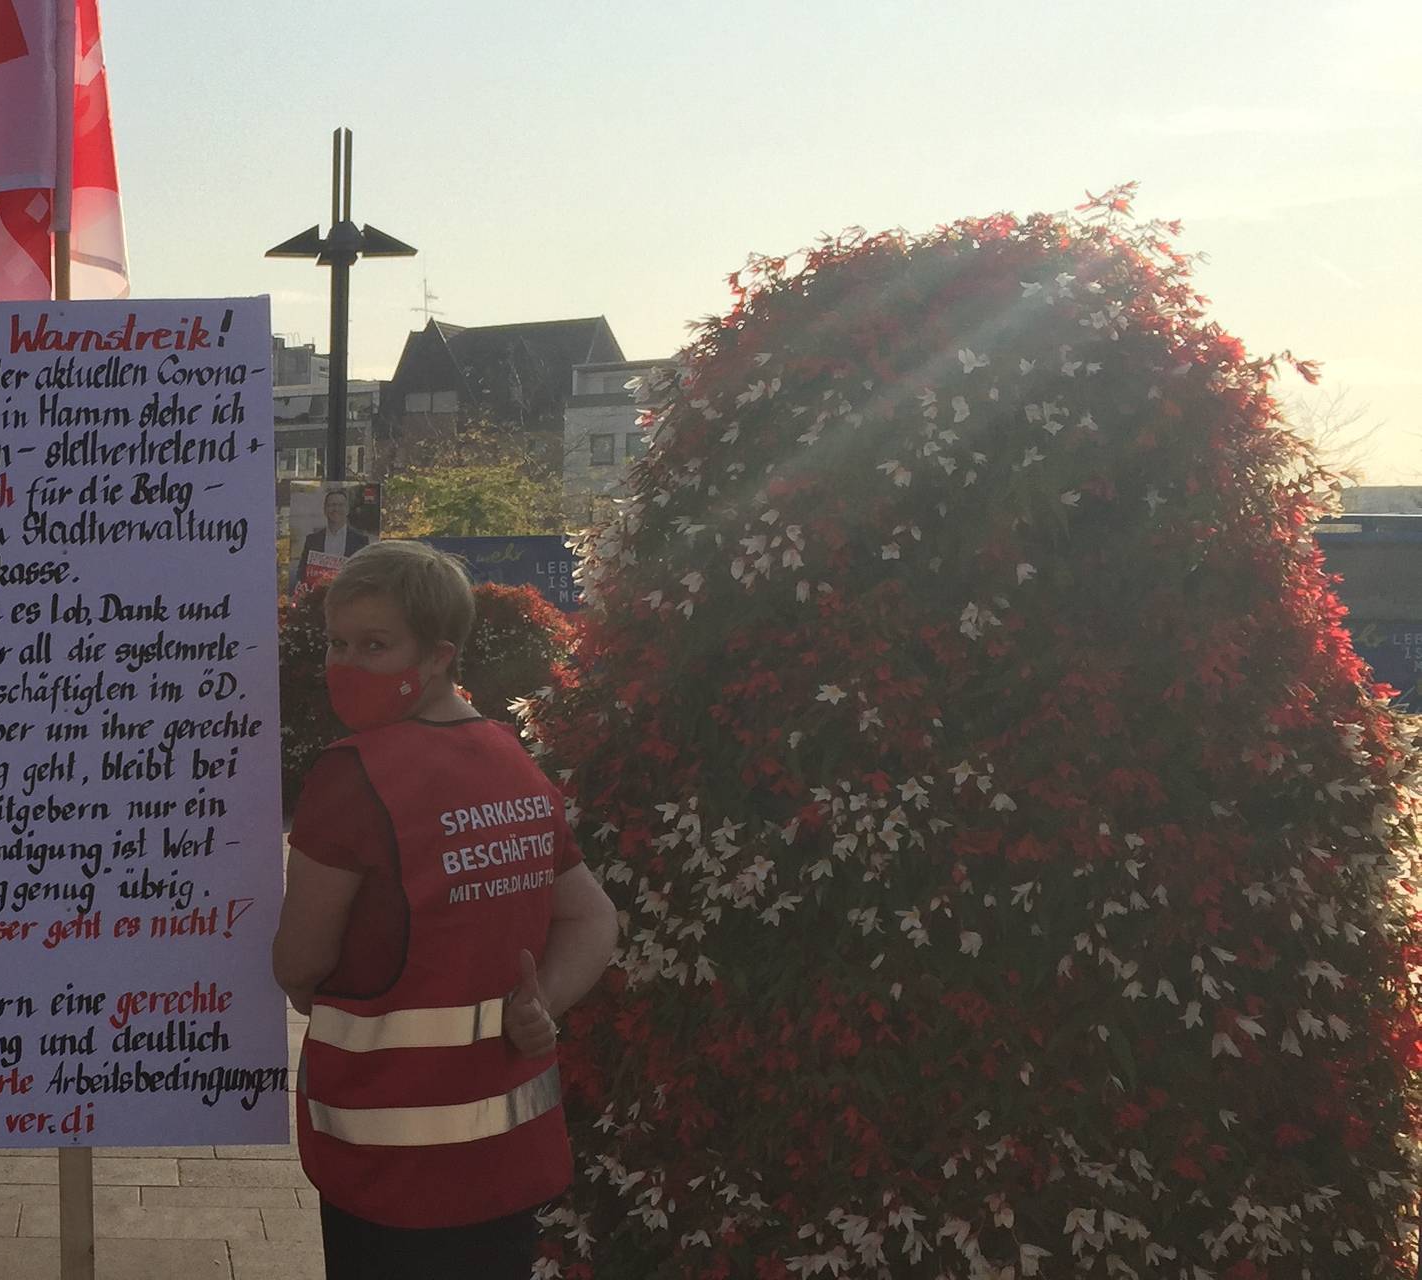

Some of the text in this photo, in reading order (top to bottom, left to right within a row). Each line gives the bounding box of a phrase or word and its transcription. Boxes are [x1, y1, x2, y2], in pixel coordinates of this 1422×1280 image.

[35, 356, 147, 390] aktuellen
[3, 399, 27, 429] in
[39, 394, 134, 427] Hamm
[139, 392, 200, 428] stehe
[212, 392, 245, 426] ich
[45, 431, 239, 469] stellvertretend
[27, 477, 73, 513] für
[79, 474, 122, 506] die
[22, 506, 248, 553] Stadtverwaltung
[11, 602, 40, 624] es
[99, 593, 169, 623] Dank
[178, 594, 230, 620] und
[19, 632, 51, 664] all
[67, 633, 106, 663] die
[149, 673, 183, 701] im
[46, 724, 89, 740] um
[101, 709, 154, 740] ihre
[158, 710, 262, 754] gerechte
[102, 748, 176, 782] bleibt
[192, 746, 239, 780] bei
[128, 800, 178, 821] nur
[185, 787, 227, 818] ein
[112, 828, 147, 859] ist
[449, 883, 482, 904] MIT
[42, 908, 102, 949] geht
[113, 916, 141, 935] es
[50, 983, 106, 1017] eine
[109, 981, 232, 1029] gerechte
[40, 1026, 97, 1056] und
[112, 1020, 231, 1054] deutlich
[45, 1056, 289, 1110] Arbeitsbedingungen
[6, 1102, 95, 1135] ver.di
